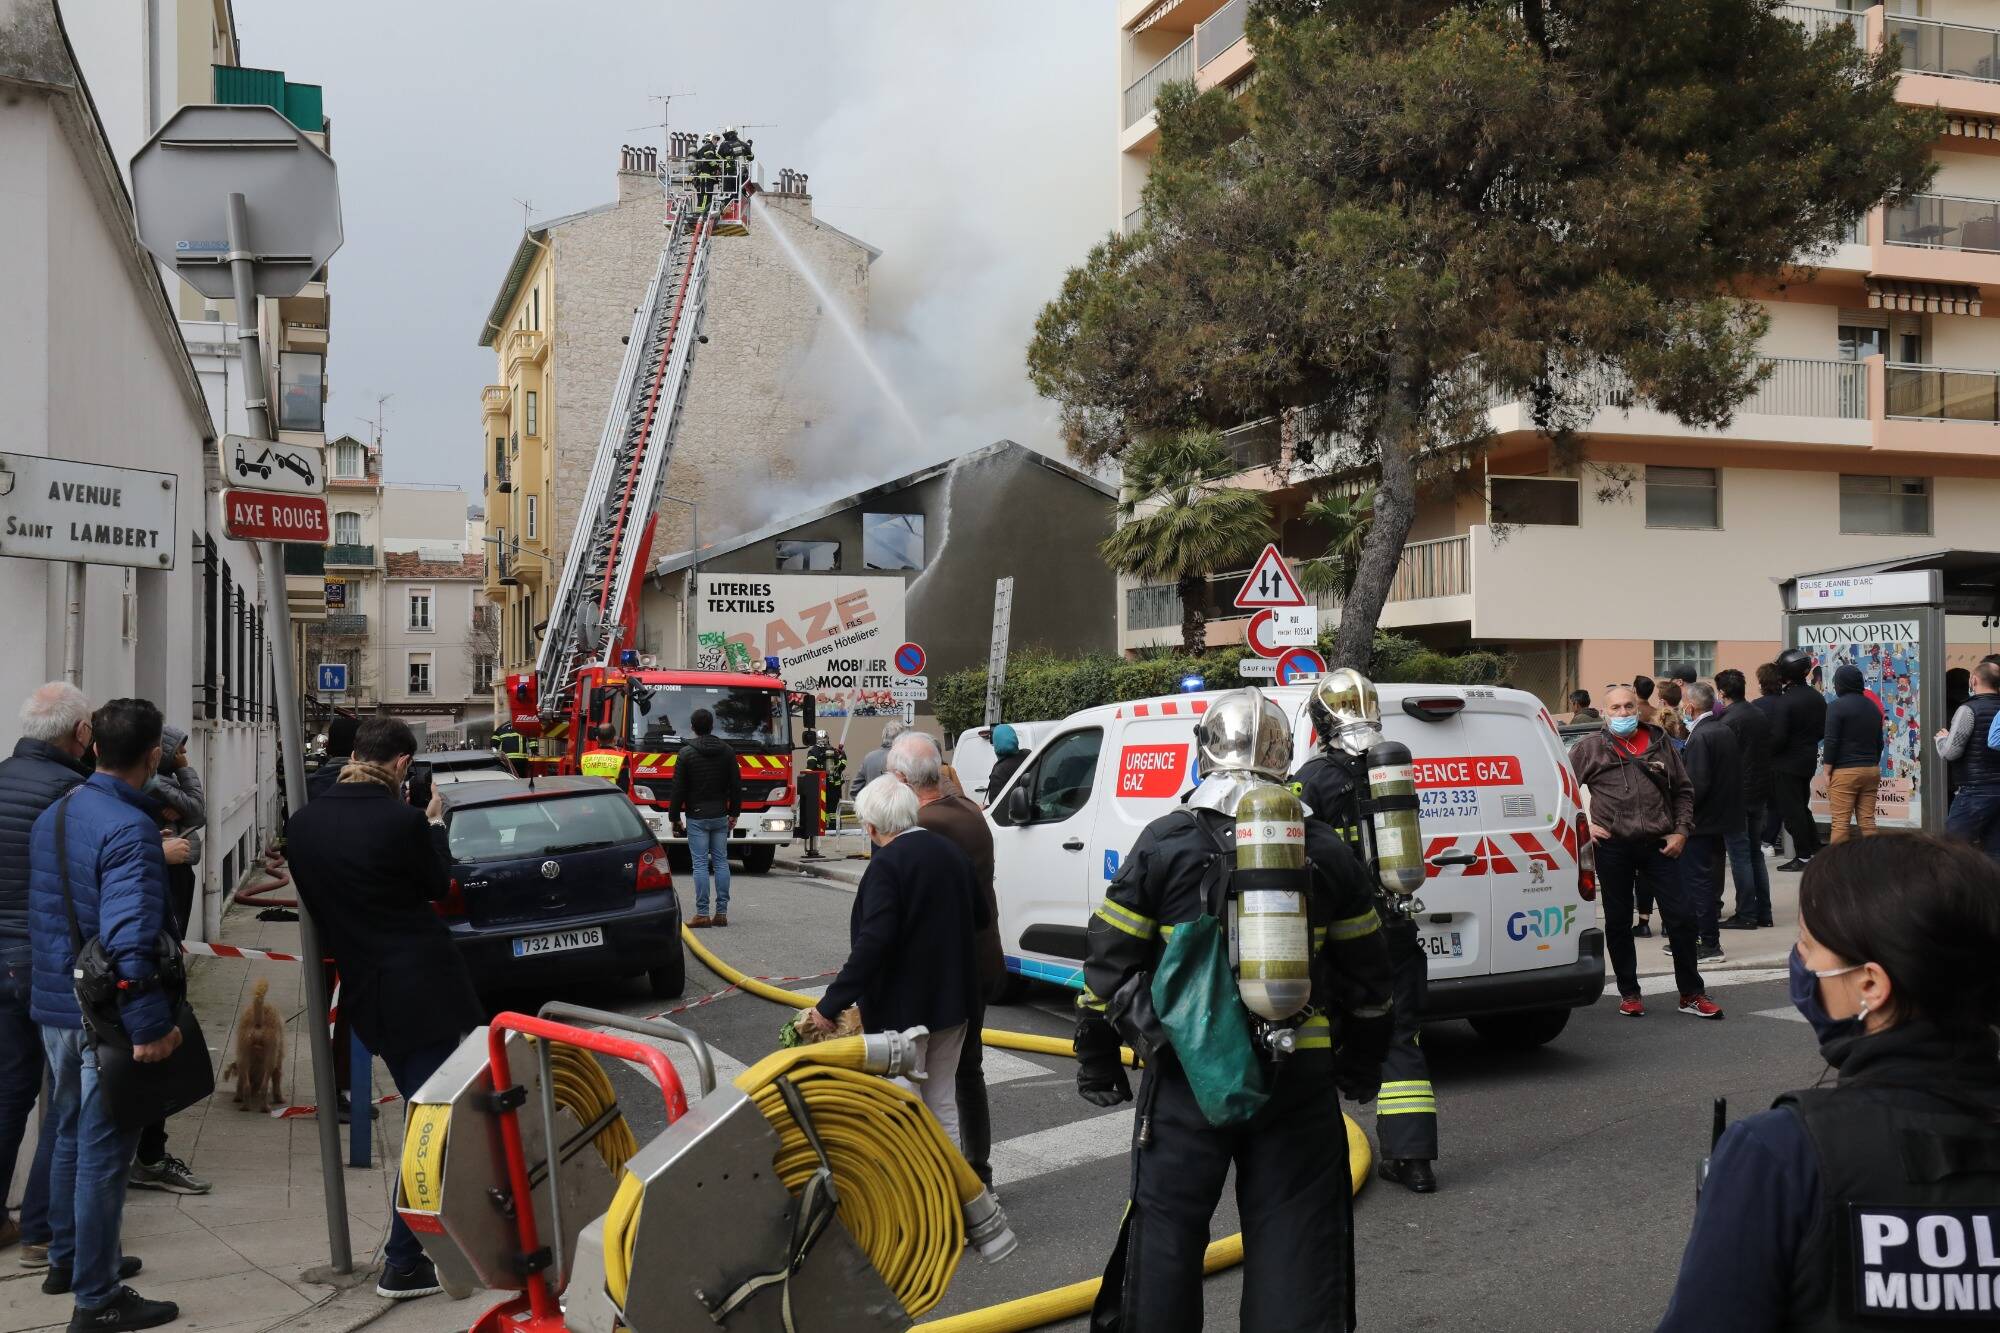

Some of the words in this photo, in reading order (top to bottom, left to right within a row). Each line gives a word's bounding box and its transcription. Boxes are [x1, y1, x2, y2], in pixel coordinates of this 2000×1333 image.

[48, 481, 122, 507] AVENUE
[234, 503, 265, 526] AXE
[272, 506, 323, 530] ROUGE
[70, 522, 159, 549] LAMBERT
[710, 582, 771, 597] LITERIES
[1825, 579, 1851, 588] JEANNE
[1853, 578, 1873, 586] D'ARC
[708, 599, 775, 614] TEXTILES
[828, 626, 839, 637] ET
[846, 618, 863, 630] FILS
[1290, 616, 1299, 624] RUE
[1294, 627, 1313, 636] FOSSAT
[1805, 622, 1914, 644] MONOPRIX
[782, 644, 834, 669] Fournitures
[827, 659, 887, 672] MOBILIER
[1126, 752, 1176, 770] URGENCE
[1476, 762, 1511, 780] GAZ
[1123, 774, 1145, 791] GAZ
[1422, 791, 1447, 804] 473
[1451, 790, 1477, 803] 333
[1419, 807, 1454, 818] 24H/24
[1458, 806, 1478, 816] 7J/7
[1507, 904, 1577, 942] GRDF
[523, 937, 550, 953] 732
[553, 932, 579, 949] AYN
[582, 931, 600, 944] 06
